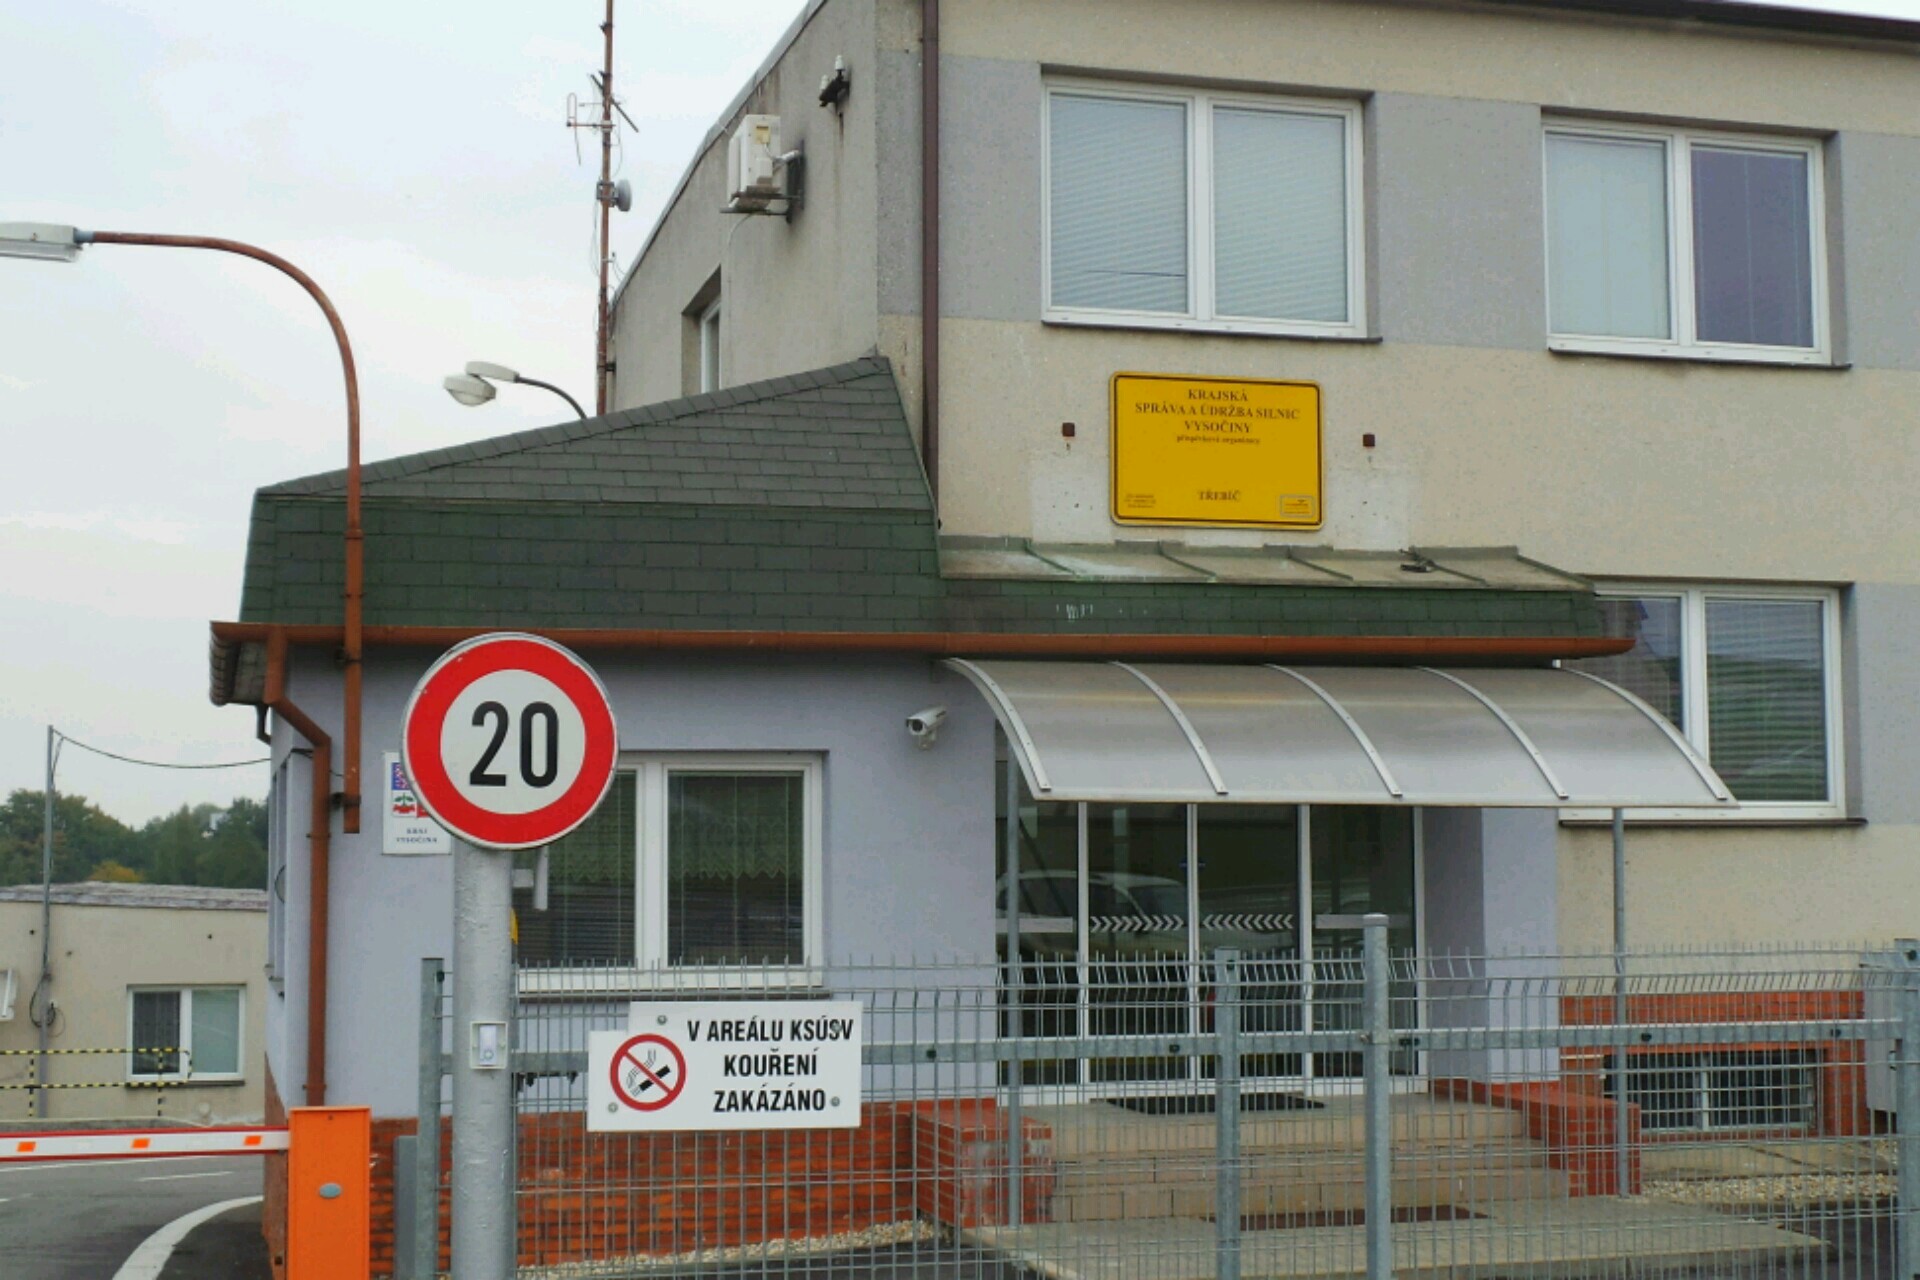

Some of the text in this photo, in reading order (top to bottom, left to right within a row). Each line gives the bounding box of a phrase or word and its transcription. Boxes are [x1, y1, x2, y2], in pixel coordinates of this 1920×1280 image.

[1188, 387, 1248, 401] KRAJSKÁ
[1135, 402, 1299, 420] SPRÁVA A ÚDRŽBA SILNIC
[1184, 419, 1251, 433] VYSOČINY
[469, 700, 559, 788] 20
[687, 1015, 854, 1041] V AREÁLU KSÚSV
[724, 1047, 820, 1077] KOUŘENÍ
[713, 1083, 826, 1112] ZAKÁZÁNO
